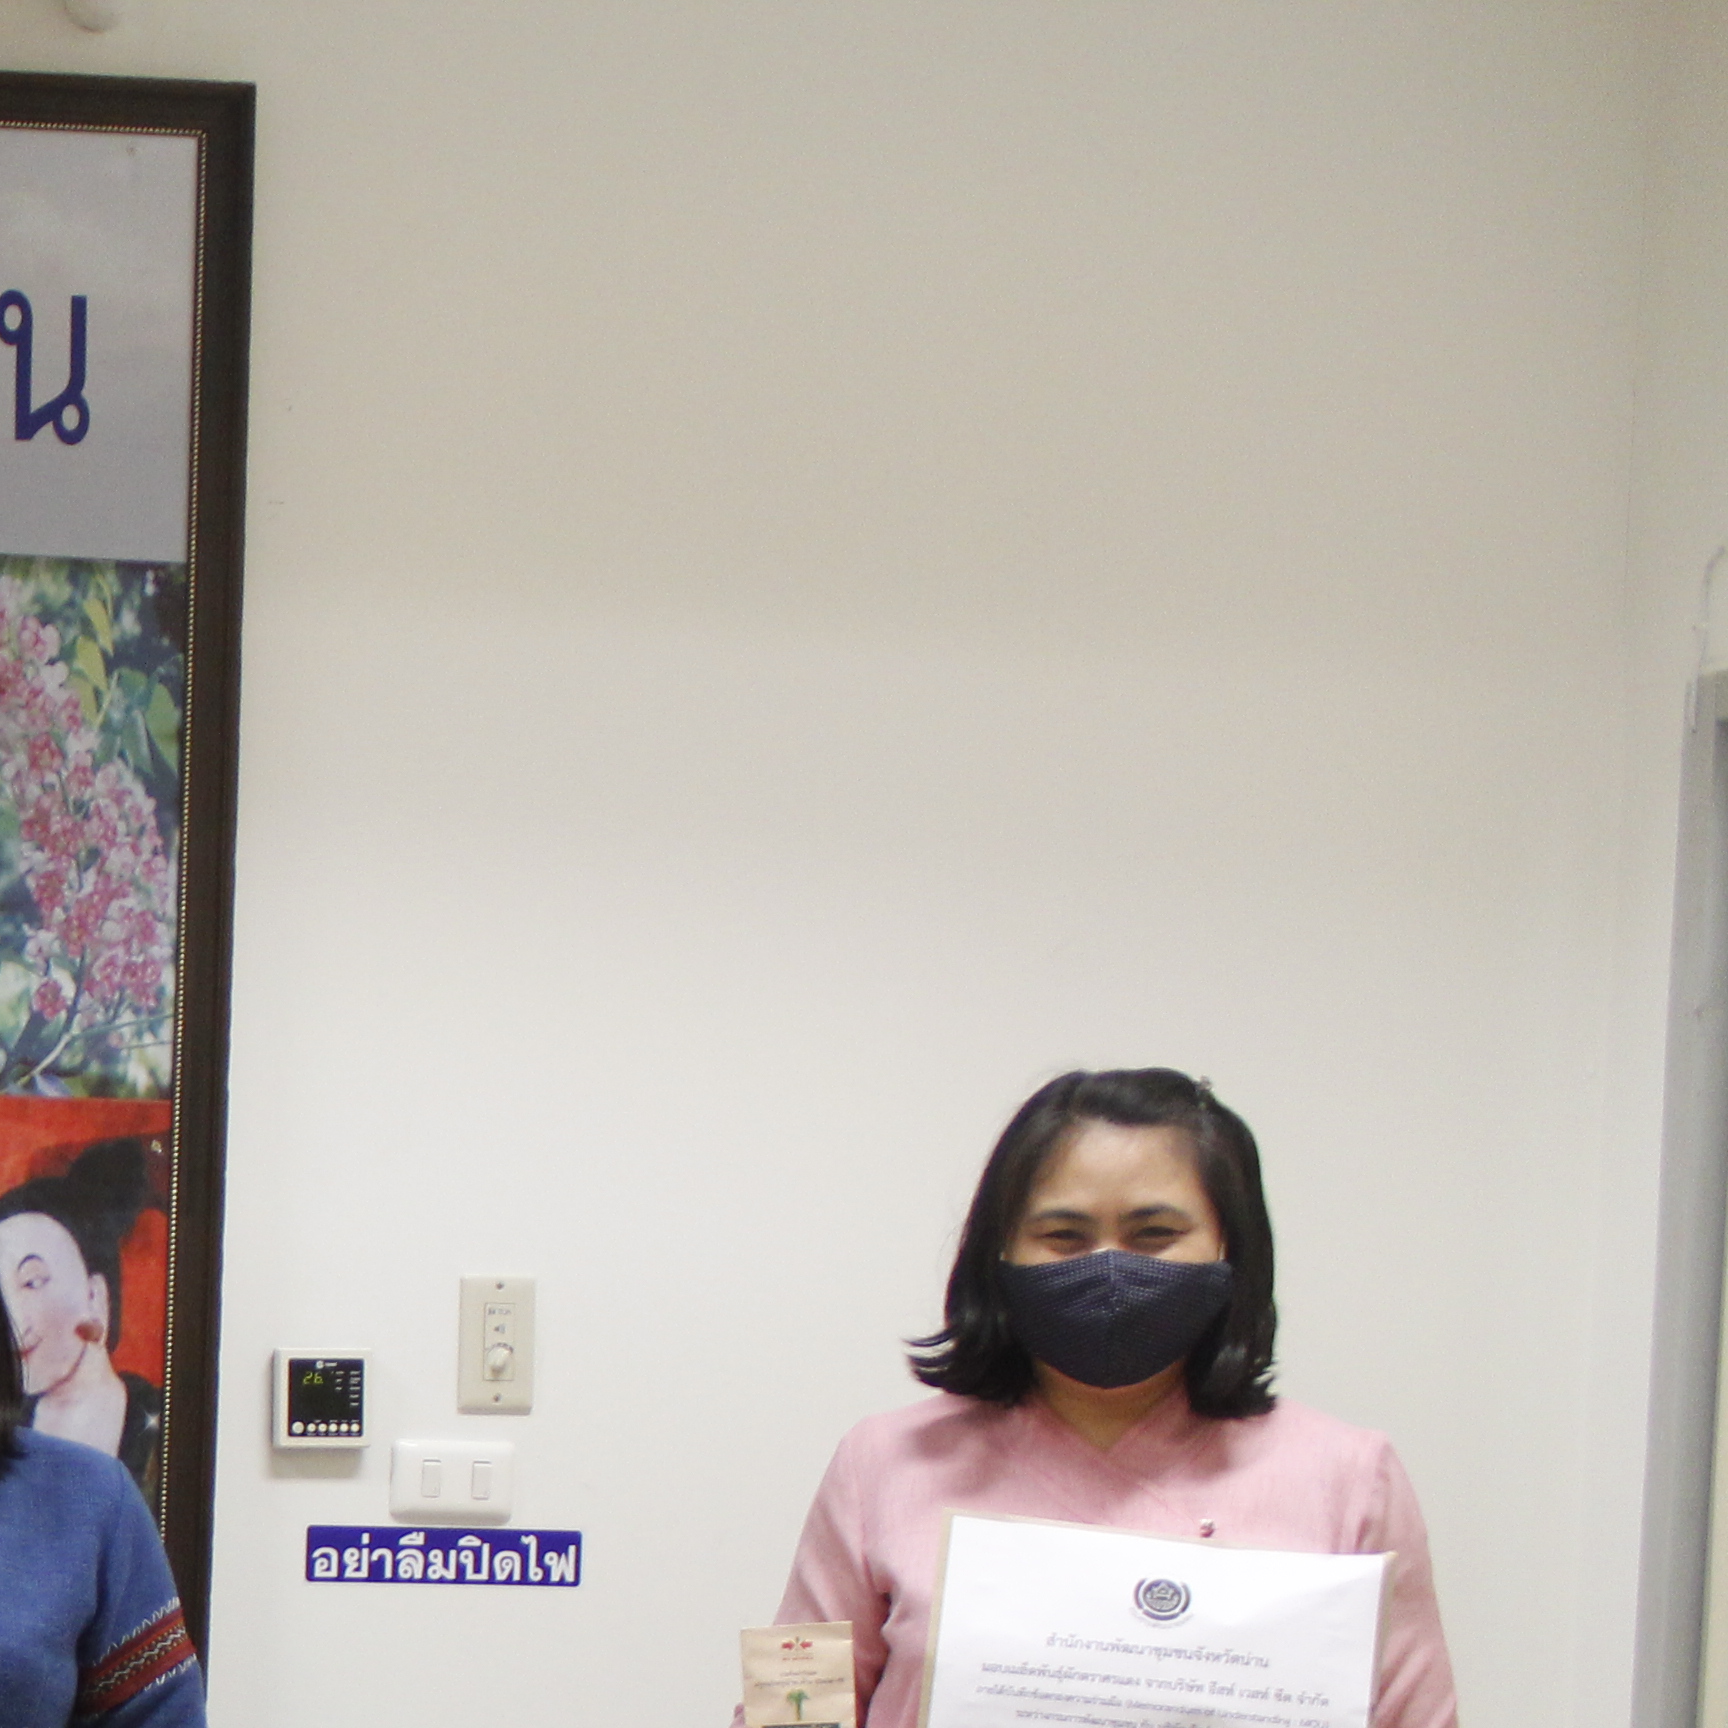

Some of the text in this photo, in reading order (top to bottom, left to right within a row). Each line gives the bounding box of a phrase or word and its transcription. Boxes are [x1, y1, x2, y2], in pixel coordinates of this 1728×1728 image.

[311, 1531, 577, 1583] อย่าลืมปิดไฟ
